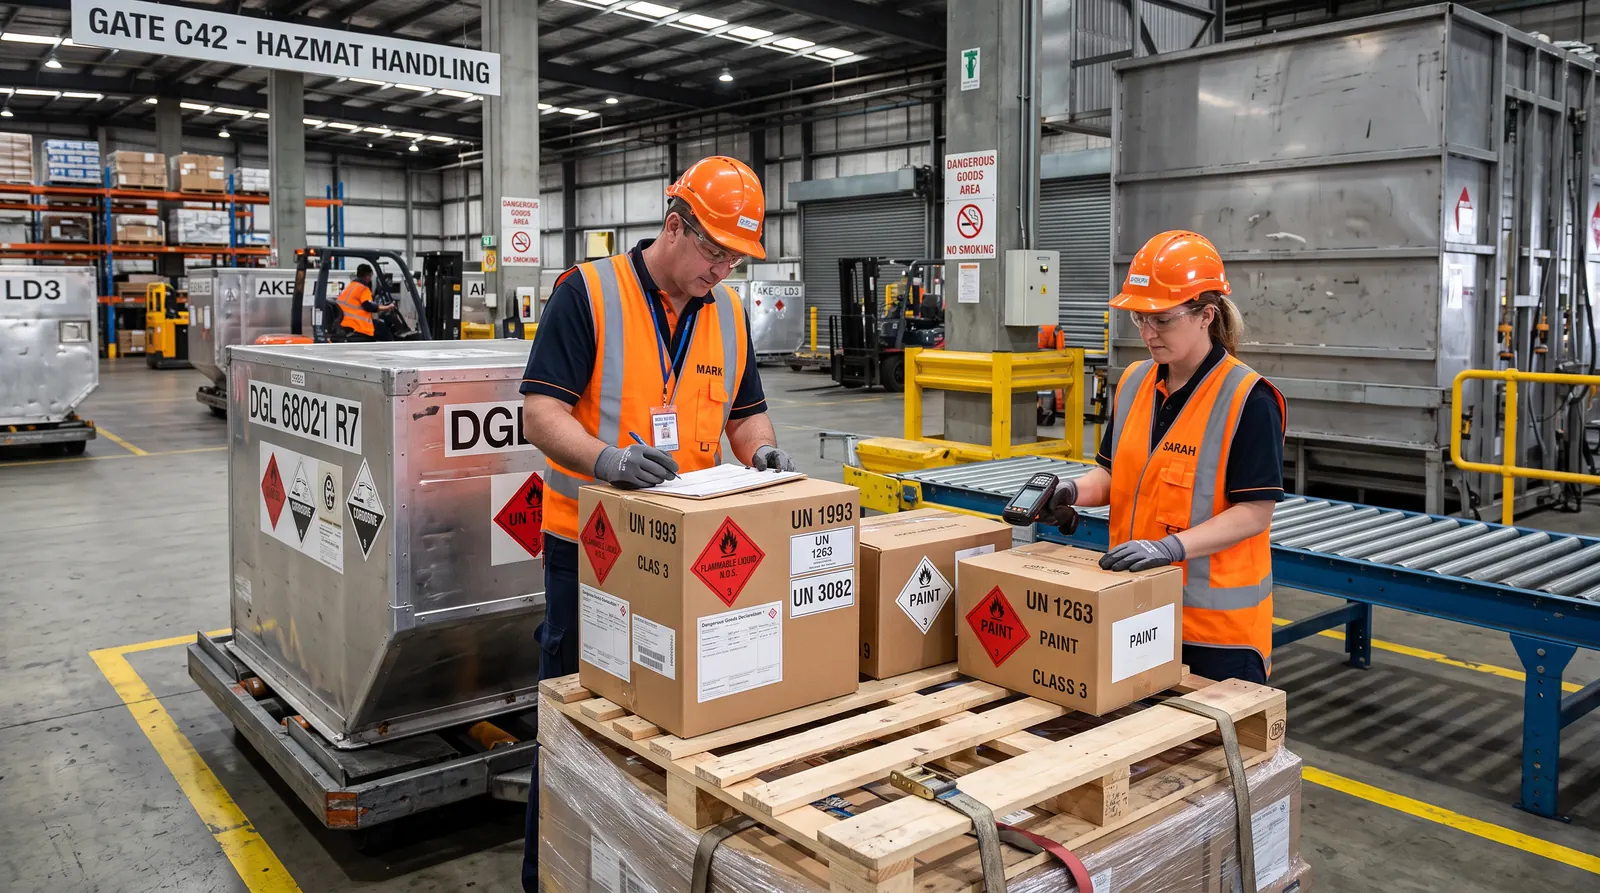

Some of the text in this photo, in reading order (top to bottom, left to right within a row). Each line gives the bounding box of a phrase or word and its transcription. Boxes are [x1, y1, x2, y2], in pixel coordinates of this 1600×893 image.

[88, 8, 165, 42] GATE
[174, 19, 228, 50] C42
[256, 30, 364, 68] HAZMAT
[371, 47, 491, 84] HANDLING
[947, 155, 995, 170] DANGEROUS
[956, 170, 984, 182] GOODS
[959, 185, 981, 195] AREA
[502, 200, 539, 209] DANGEROUS
[946, 244, 994, 255] NO SMOKING
[6, 279, 61, 300] LD3
[258, 281, 295, 295] AKE
[784, 287, 799, 295] LD3
[696, 364, 723, 377] MARK
[250, 384, 359, 447] DGL 68021 R7
[451, 406, 533, 451] DGL
[1162, 441, 1197, 456] SARAH
[509, 511, 527, 526] UN
[791, 502, 853, 530] UN 1993
[629, 511, 677, 545] UN 1993
[532, 537, 538, 547] 3
[815, 534, 829, 546] UN
[811, 547, 833, 559] 1263
[637, 554, 669, 579] CLAS 3
[700, 554, 757, 573] FLAMMABLE LIQUID
[719, 568, 738, 579] N.O.S.
[727, 587, 732, 597] 3
[793, 578, 852, 607] UN 3082
[909, 588, 941, 607] PAINT
[1026, 589, 1093, 624] UN 1263
[923, 617, 928, 626] 3
[980, 619, 1014, 640] PAINT
[1040, 630, 1079, 655] PAINT
[1129, 626, 1158, 649] PAINT
[994, 648, 999, 657] 3
[1032, 668, 1087, 699] CLASS 3
